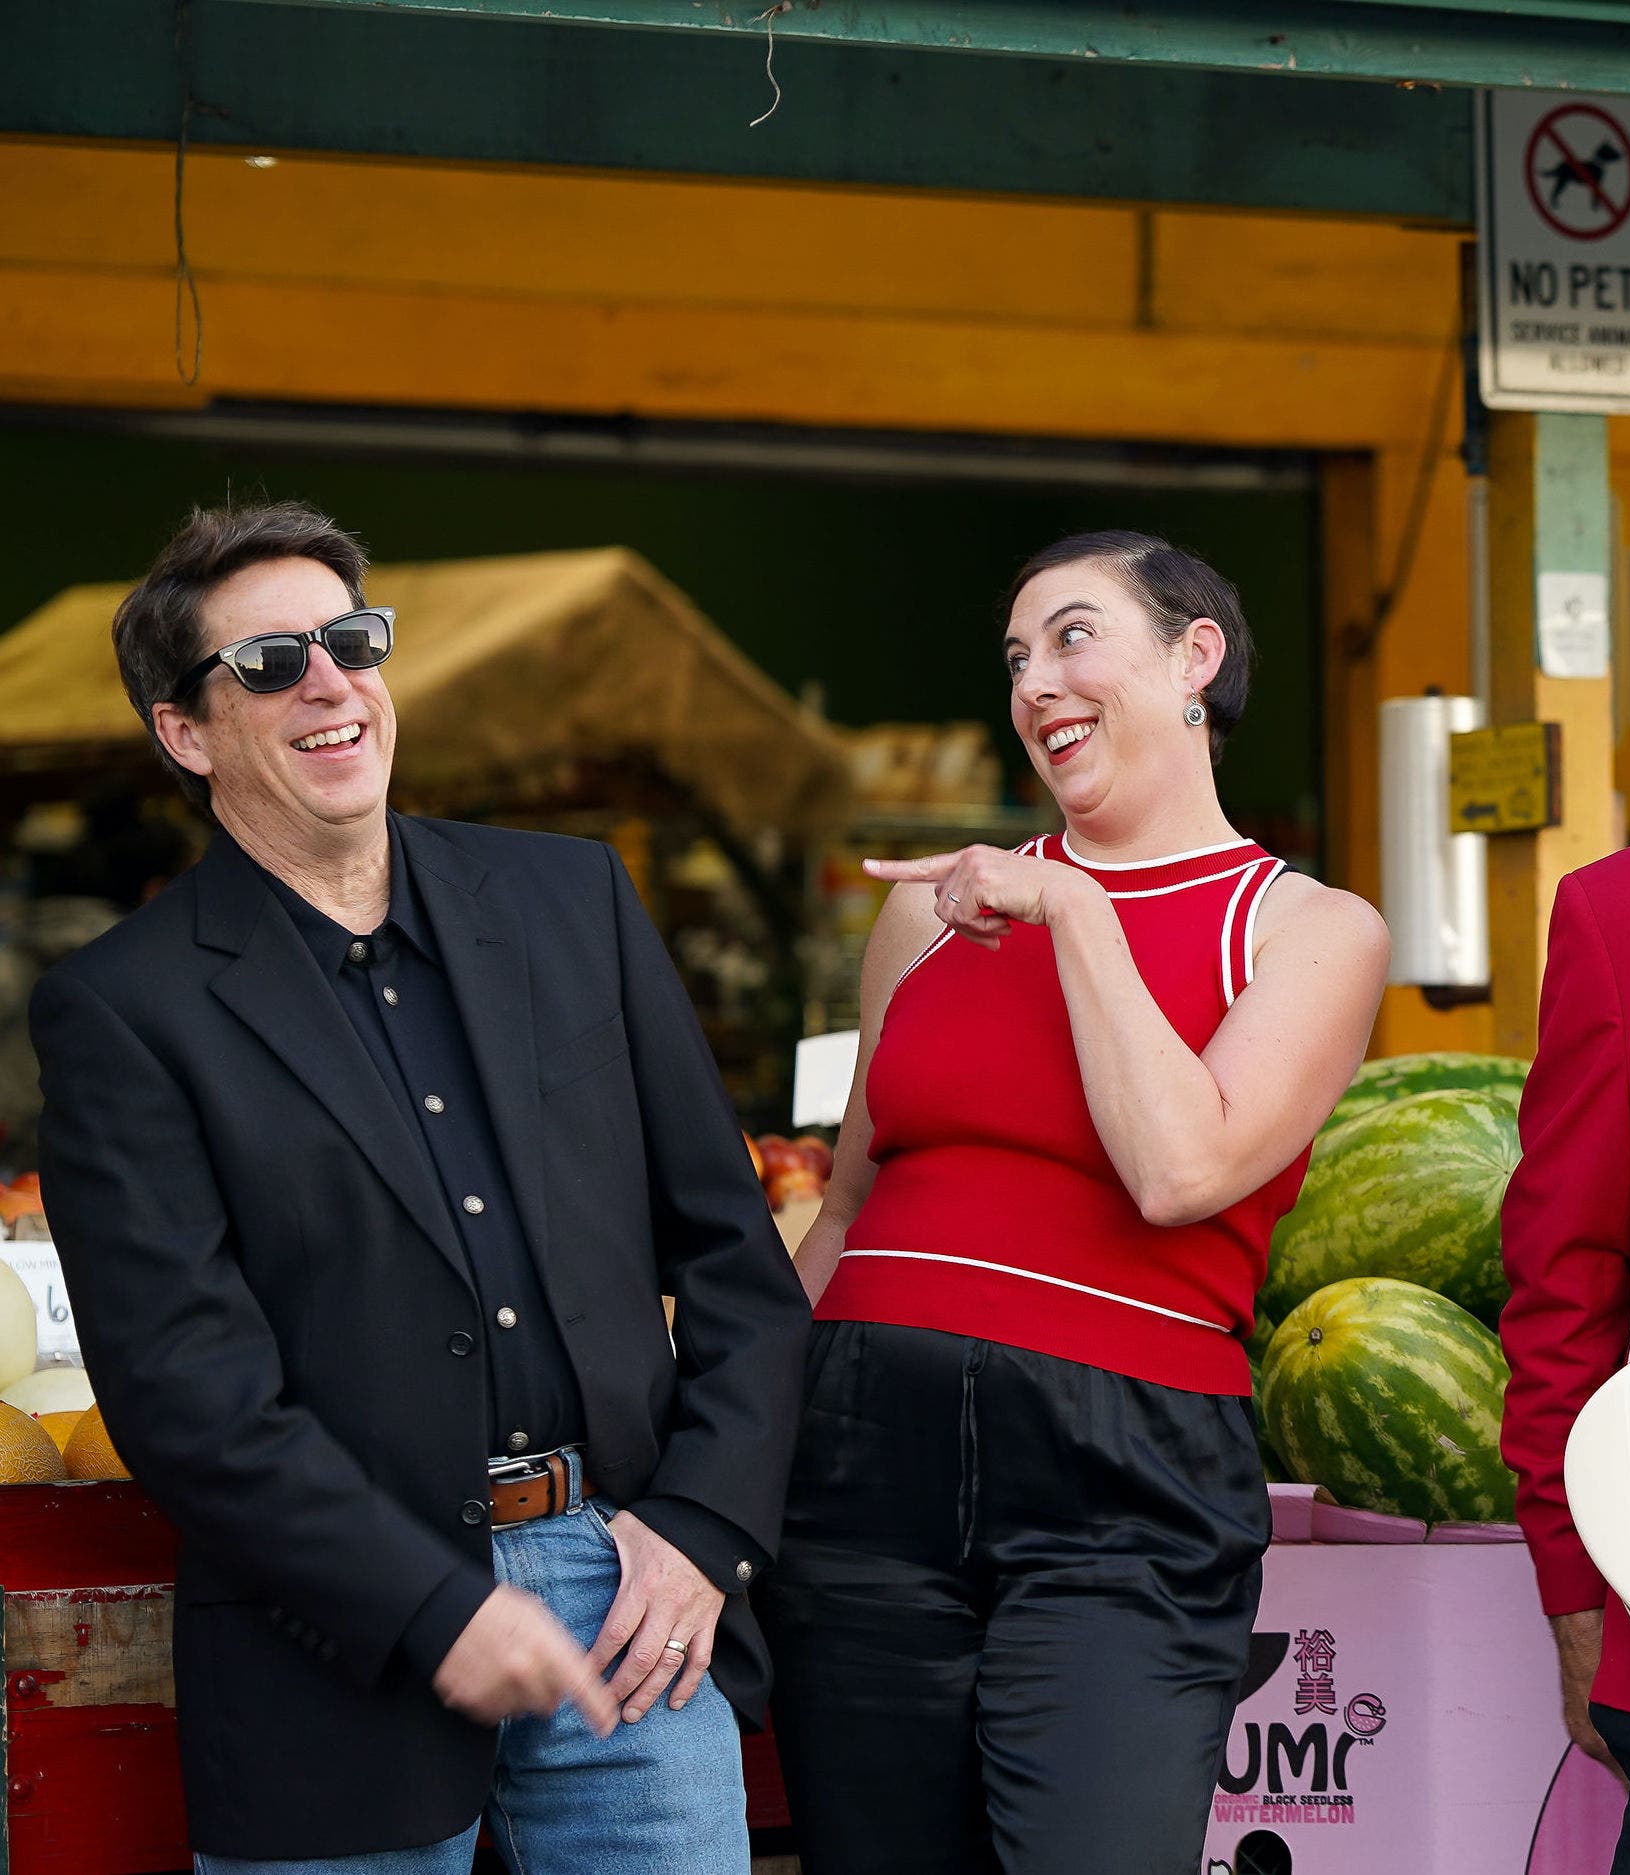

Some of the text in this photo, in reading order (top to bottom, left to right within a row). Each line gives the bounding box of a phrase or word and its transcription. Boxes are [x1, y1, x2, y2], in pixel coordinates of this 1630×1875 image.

[1509, 261, 1557, 306] NO
[1511, 319, 1579, 345] SERVICE
[1293, 1629, 1338, 1716] 裕美
[1217, 1722, 1357, 1795] UMI
[1214, 1804, 1356, 1825] WATERMELON
[1263, 1795, 1297, 1806] BLACK
[1299, 1795, 1354, 1806] SEEDLESS
